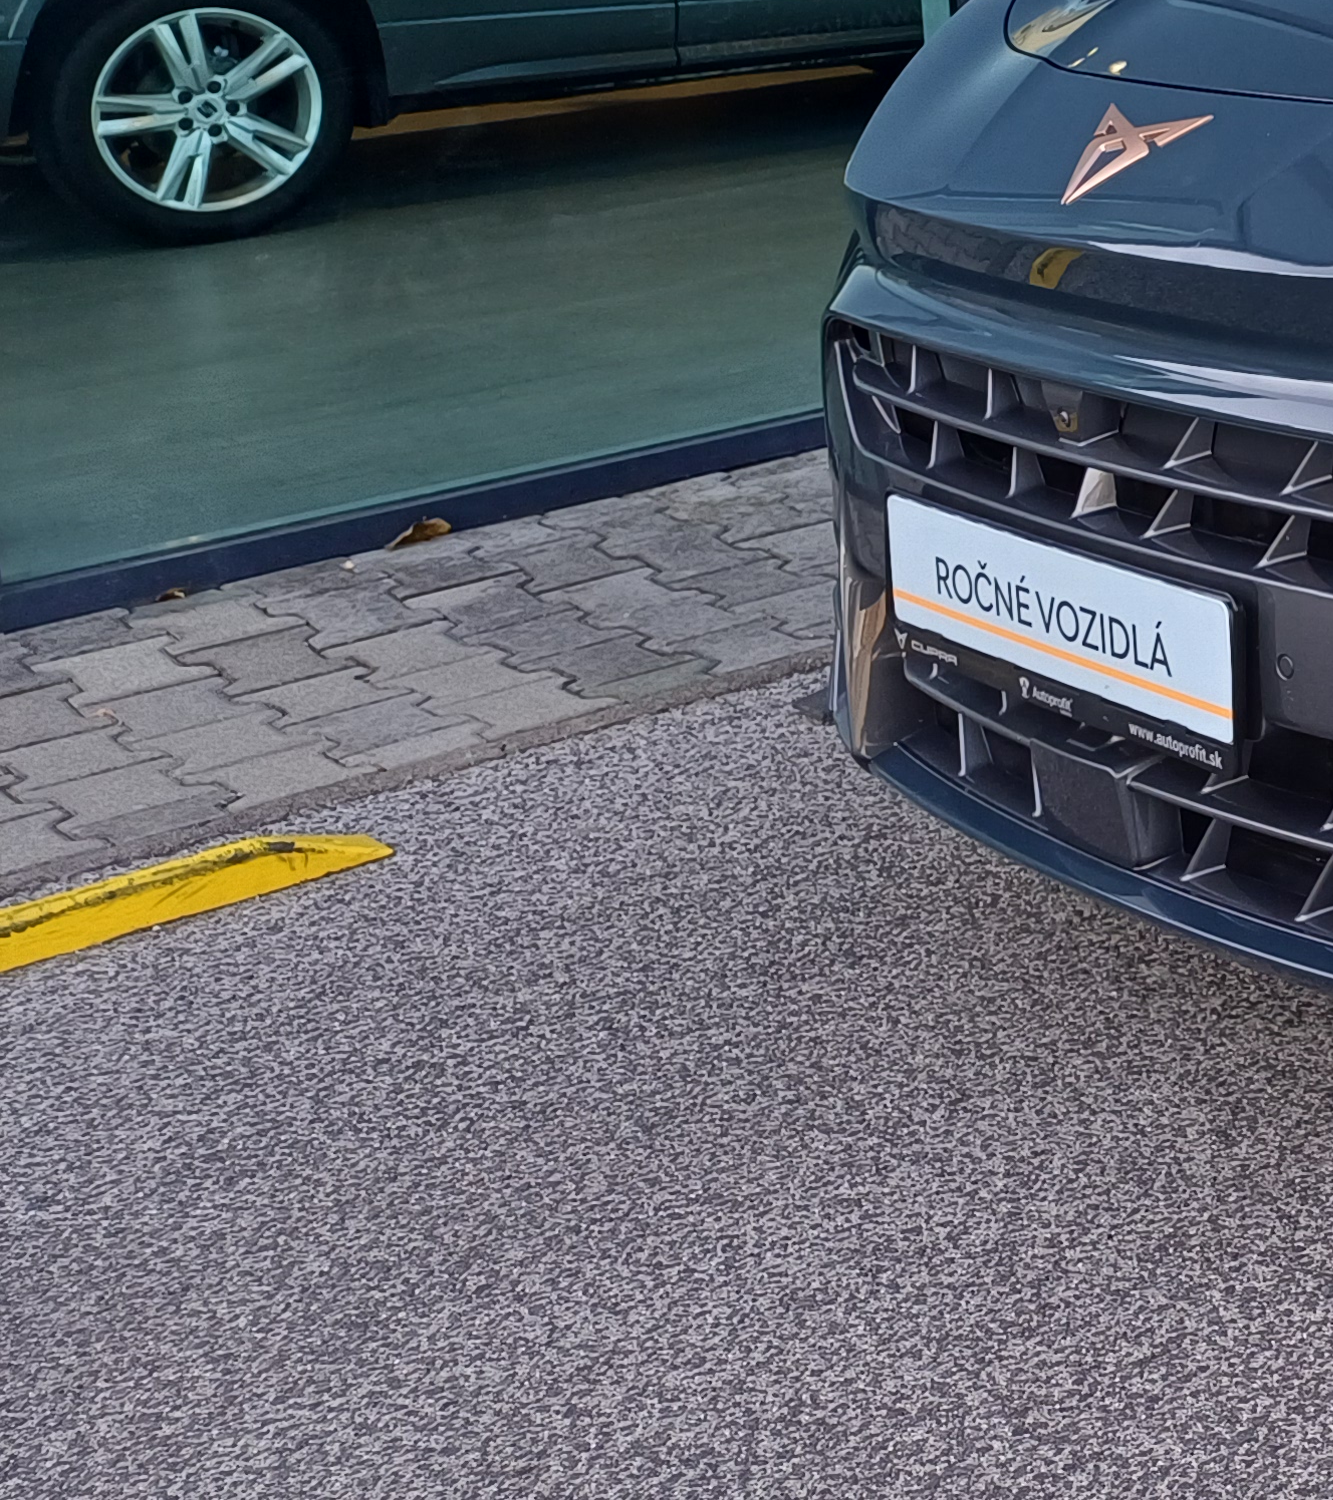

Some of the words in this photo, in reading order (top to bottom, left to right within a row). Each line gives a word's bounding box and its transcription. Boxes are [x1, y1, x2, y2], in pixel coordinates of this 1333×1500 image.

[935, 556, 1033, 628] ROČNÉ
[1035, 590, 1173, 678] VOZIDLÁ
[1128, 722, 1223, 771] www.autoprofit.sk
